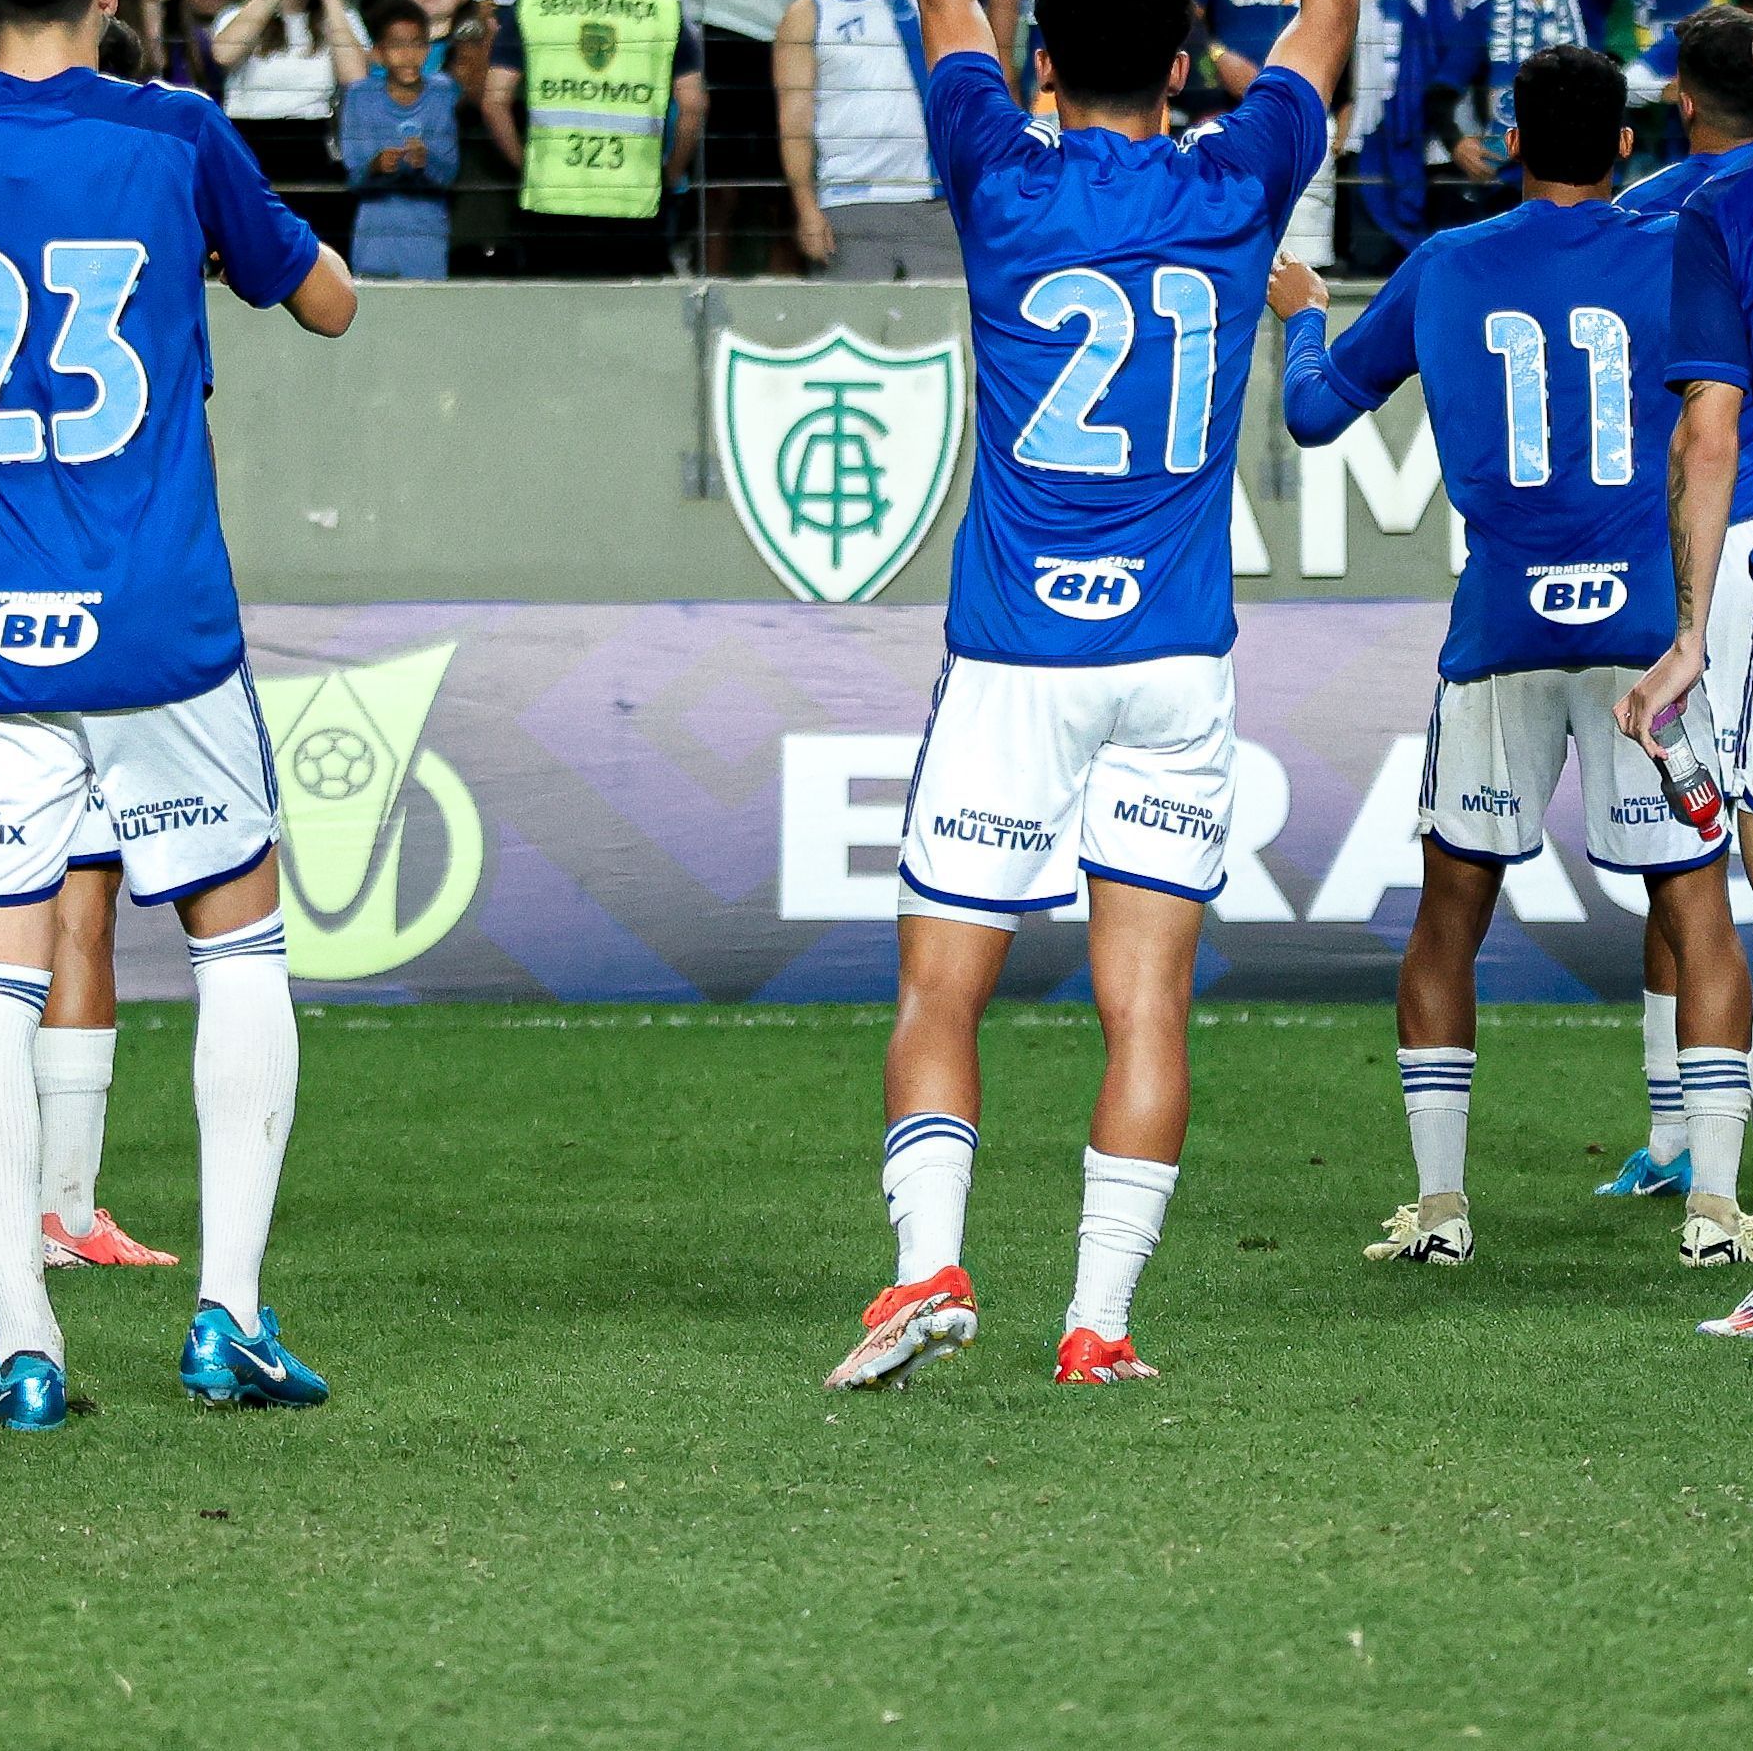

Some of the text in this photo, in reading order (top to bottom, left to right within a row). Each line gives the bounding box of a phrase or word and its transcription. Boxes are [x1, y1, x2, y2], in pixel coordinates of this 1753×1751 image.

[539, 78, 653, 104] BROMO
[565, 133, 626, 170] 323
[1012, 264, 1219, 476] 21
[1485, 307, 1634, 489] 11
[1525, 562, 1629, 577] SUPERMERCADOS
[1048, 573, 1126, 606] BH
[1542, 580, 1614, 612] BH
[0, 614, 84, 649] BH
[120, 796, 204, 820] FACULDADE
[1142, 795, 1213, 820] FACULDAD
[1686, 781, 1715, 812] TNT
[933, 816, 1057, 852] MULTIVIX
[959, 808, 1042, 831] FACULDADE
